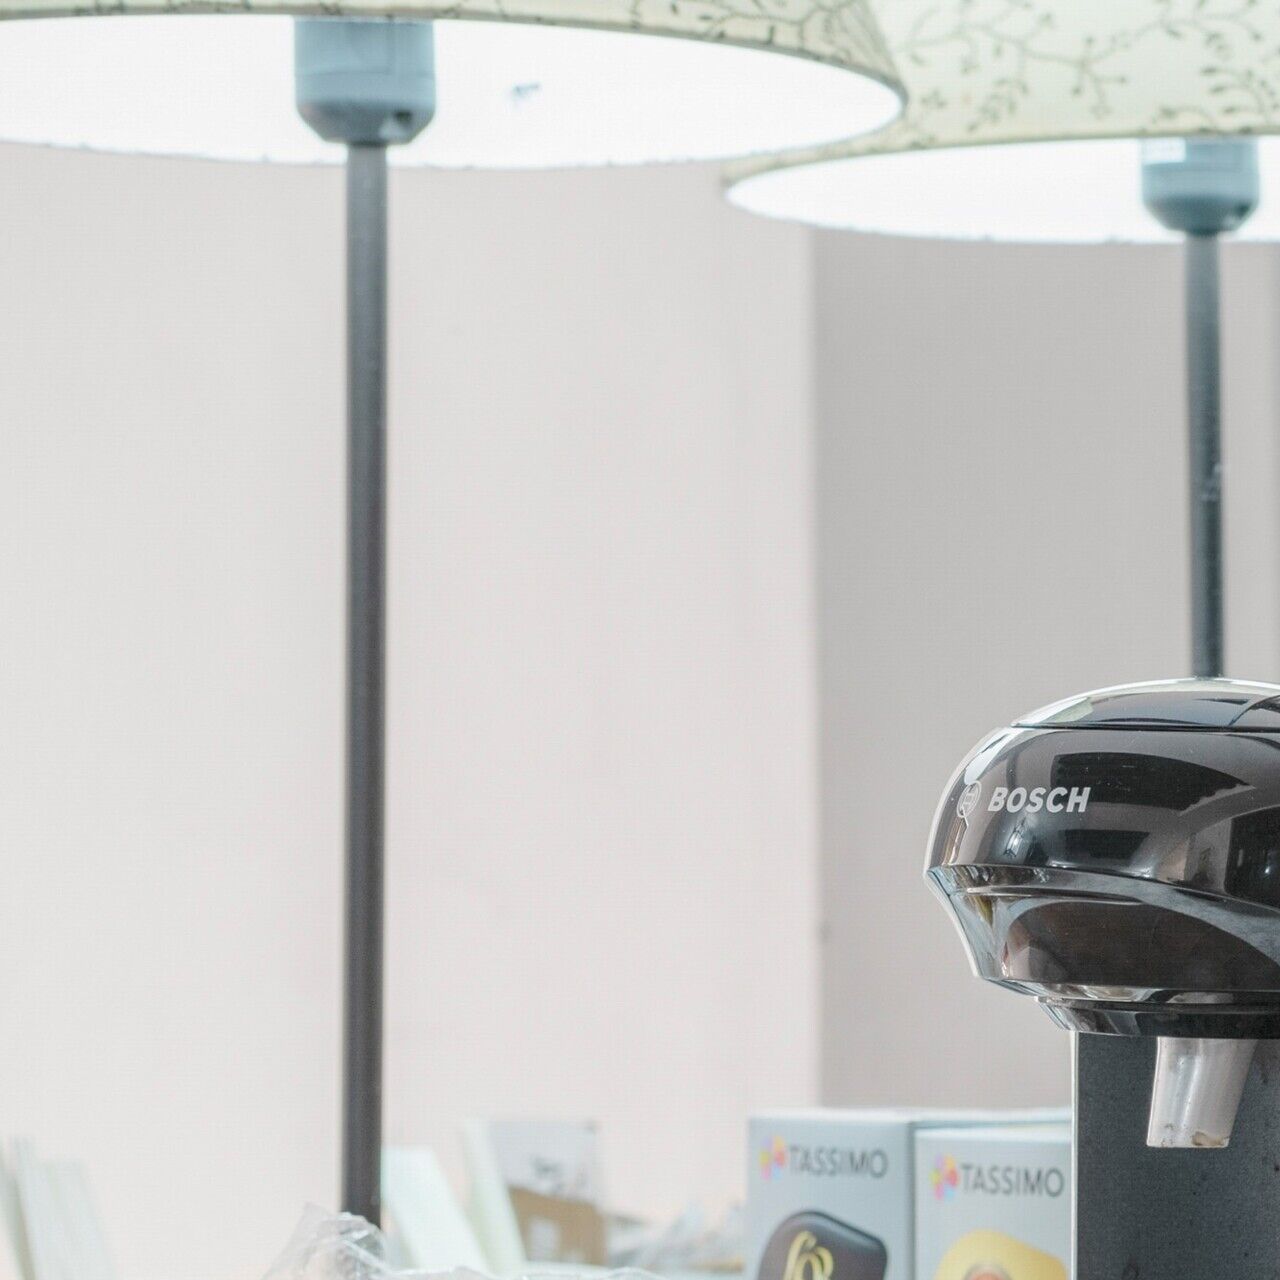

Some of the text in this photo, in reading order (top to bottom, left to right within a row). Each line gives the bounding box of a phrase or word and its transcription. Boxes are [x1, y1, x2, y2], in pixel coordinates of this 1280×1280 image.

[987, 786, 1092, 813] BOSCH
[788, 1145, 889, 1179] TASSIMO
[959, 1163, 1066, 1198] TASSIMO
